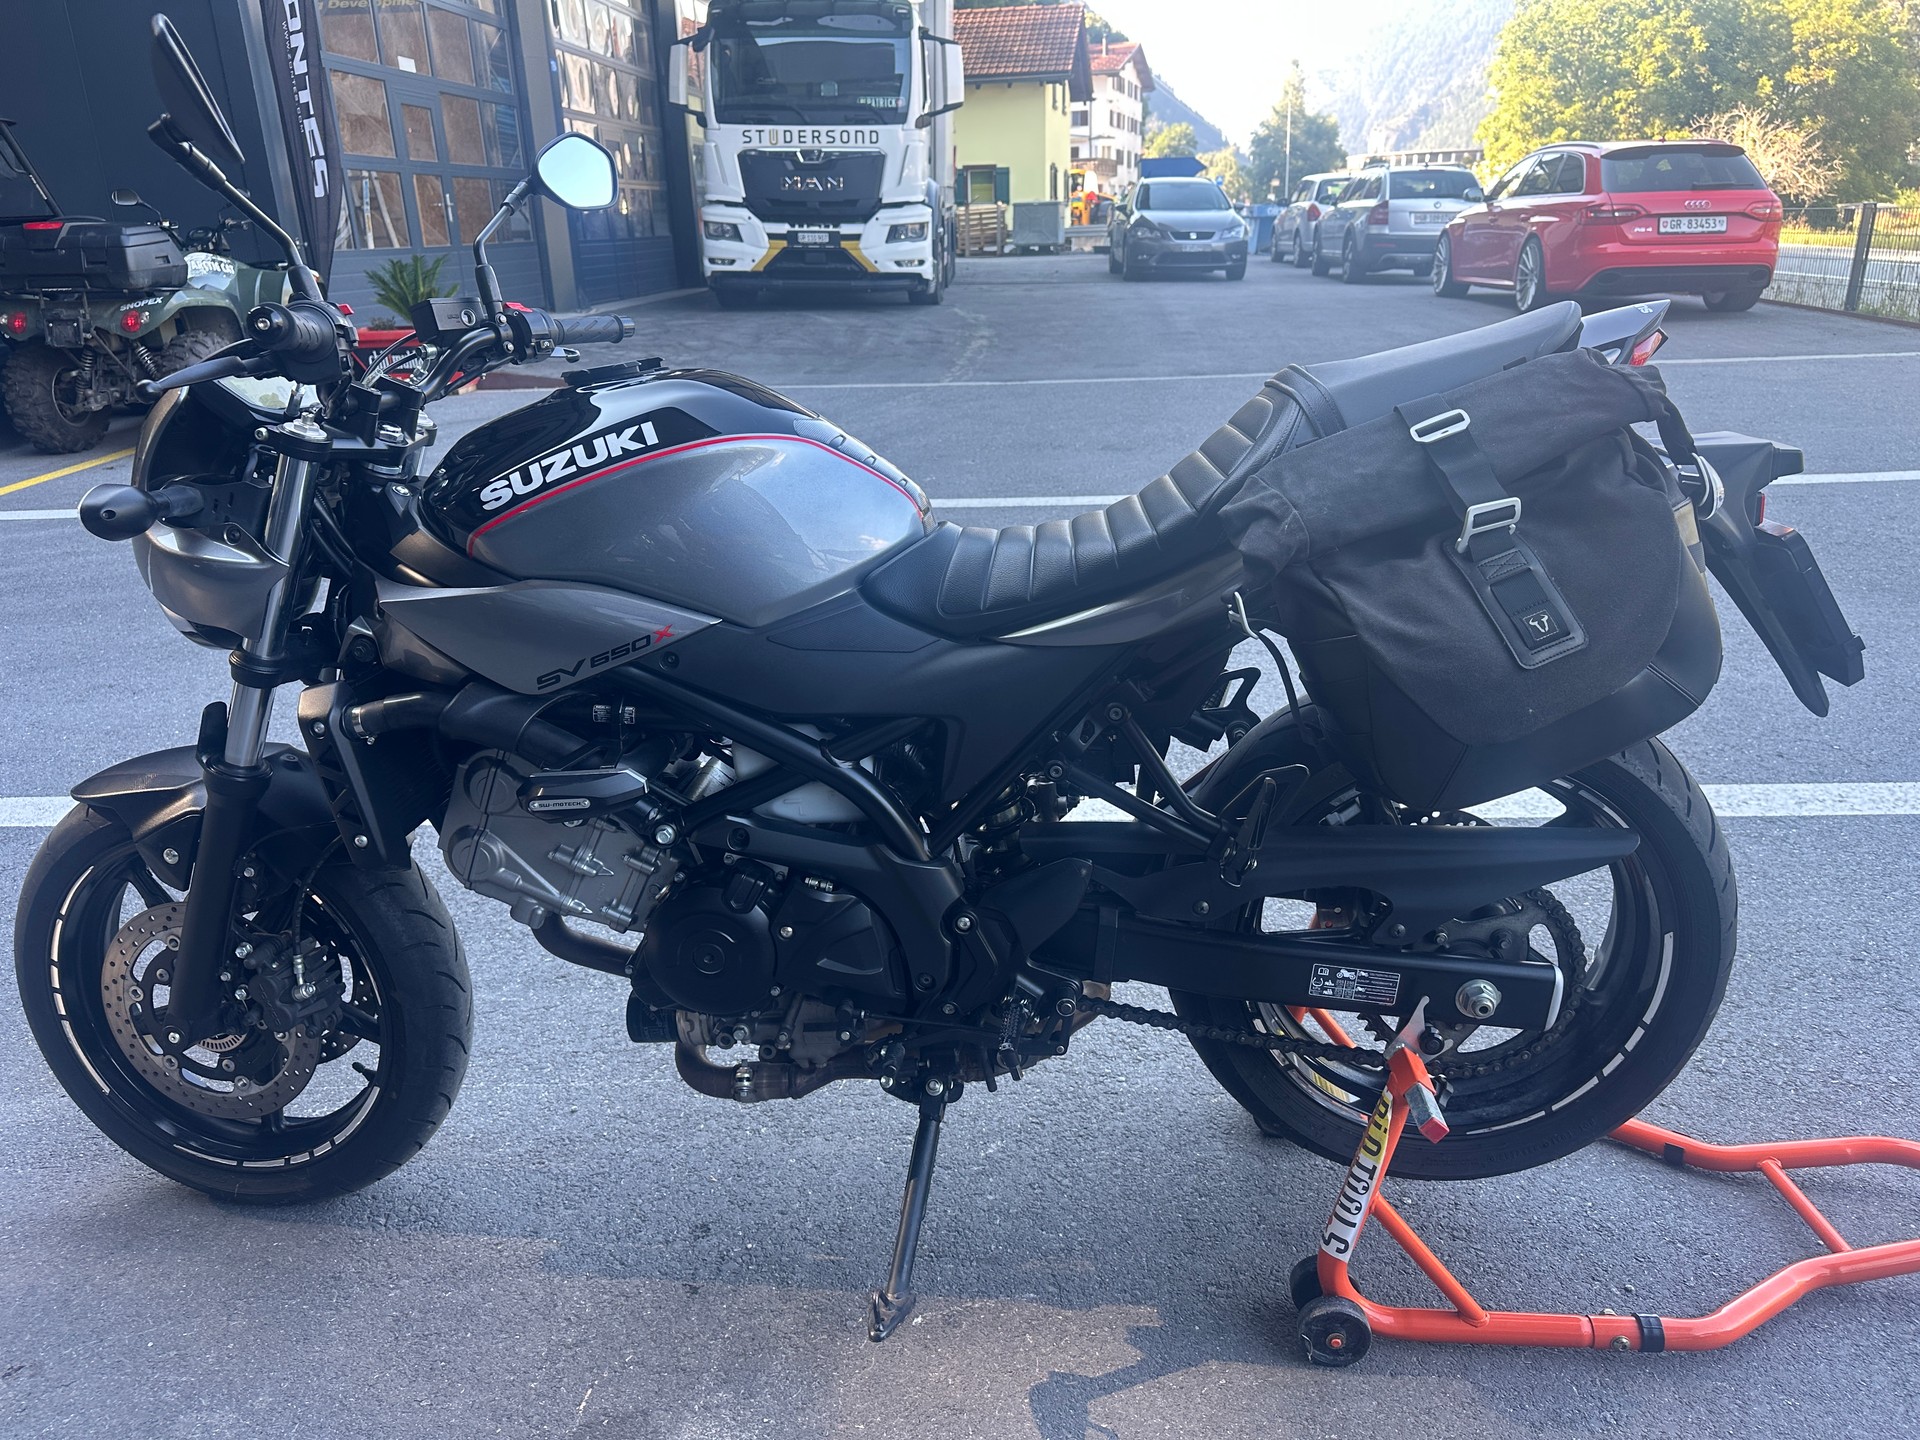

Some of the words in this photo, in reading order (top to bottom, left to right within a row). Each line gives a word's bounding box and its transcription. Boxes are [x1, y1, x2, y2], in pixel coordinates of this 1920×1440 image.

[742, 129, 880, 146] STUDERSOND
[780, 176, 844, 191] MAN
[120, 296, 165, 311] SNOPEX
[479, 420, 660, 511] SUZUKI
